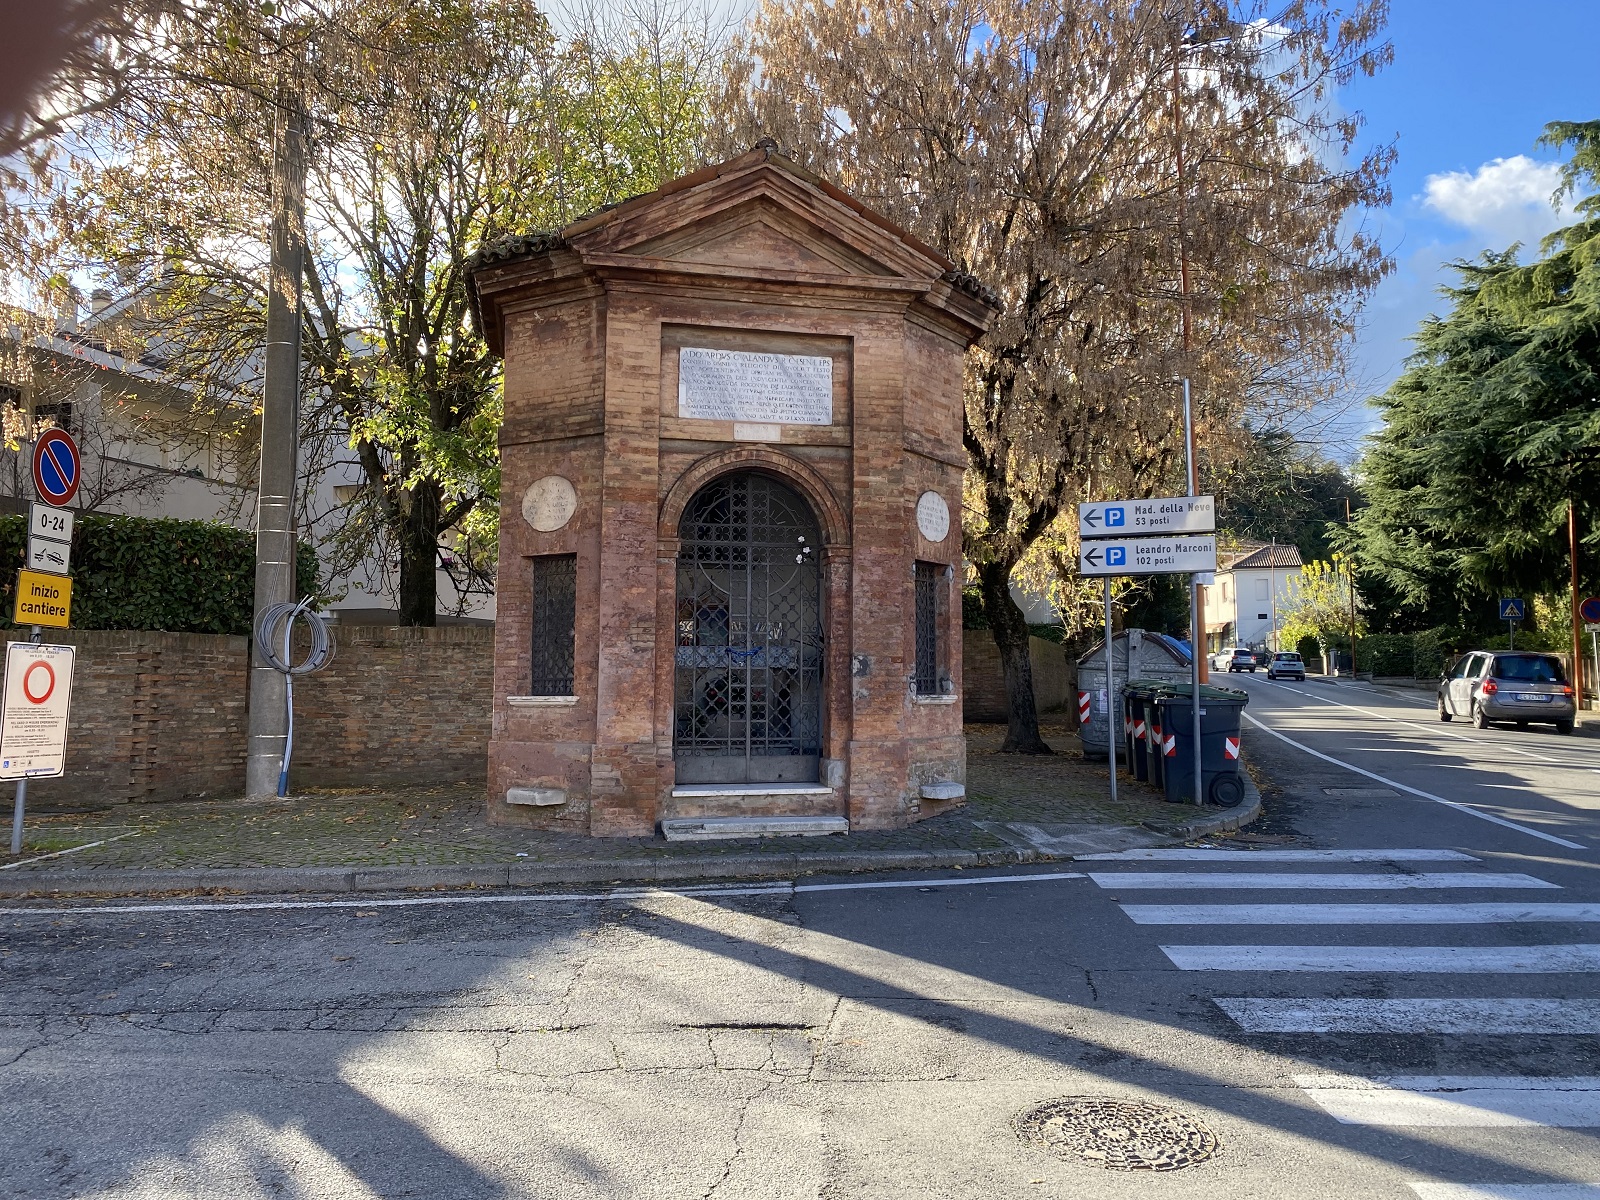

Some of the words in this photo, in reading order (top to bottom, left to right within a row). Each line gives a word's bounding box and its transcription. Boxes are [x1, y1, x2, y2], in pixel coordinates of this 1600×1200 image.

[1135, 505, 1156, 515] Mad.
[1160, 503, 1184, 513] della
[1187, 502, 1211, 512] Neve
[41, 513, 65, 532] 0-24
[1109, 510, 1121, 525] P
[1135, 517, 1146, 526] 53
[1150, 516, 1170, 527] posti
[1110, 549, 1122, 564] P
[1135, 544, 1171, 555] Leandro
[1175, 543, 1212, 553] Marconi
[1136, 556, 1151, 565] 102
[1154, 555, 1175, 566] posti
[30, 582, 60, 599] inizio
[20, 601, 66, 617] cantiere
